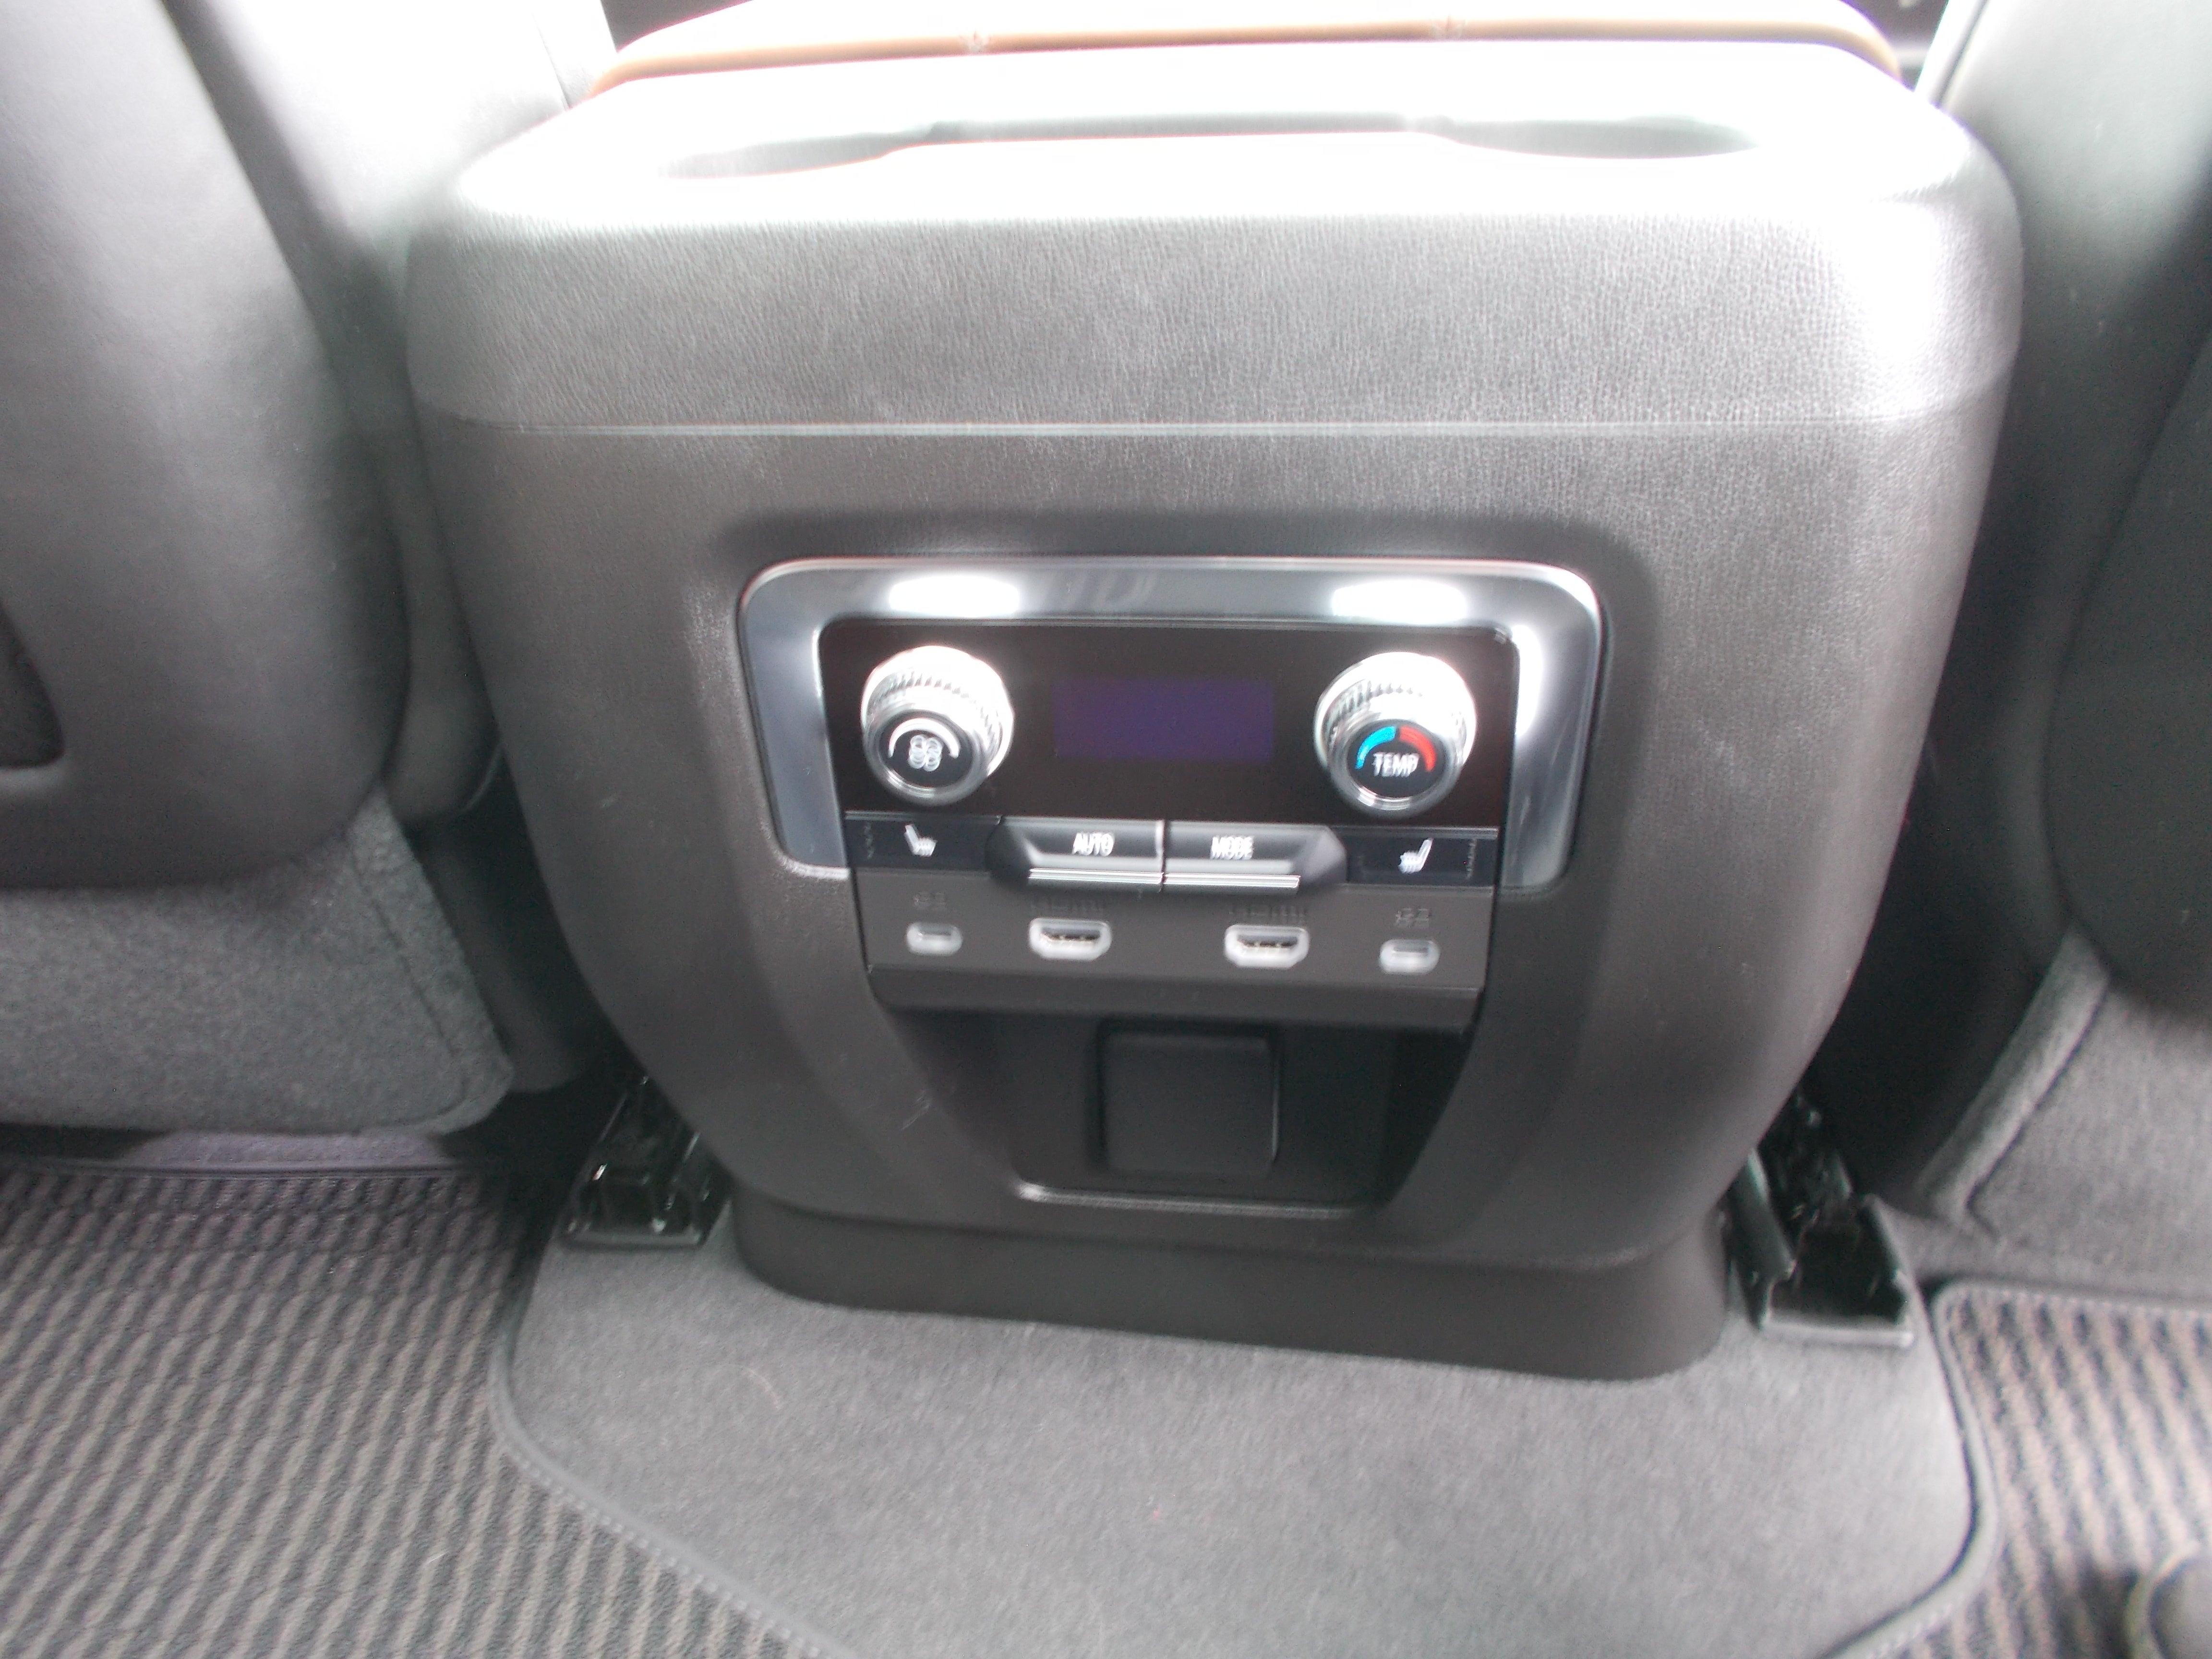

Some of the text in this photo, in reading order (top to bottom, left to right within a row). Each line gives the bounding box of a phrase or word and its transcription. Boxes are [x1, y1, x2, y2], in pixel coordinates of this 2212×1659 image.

[1372, 753, 1419, 777] TEMP
[1072, 832, 1114, 856] AUTO
[1211, 836, 1254, 859] MODE
